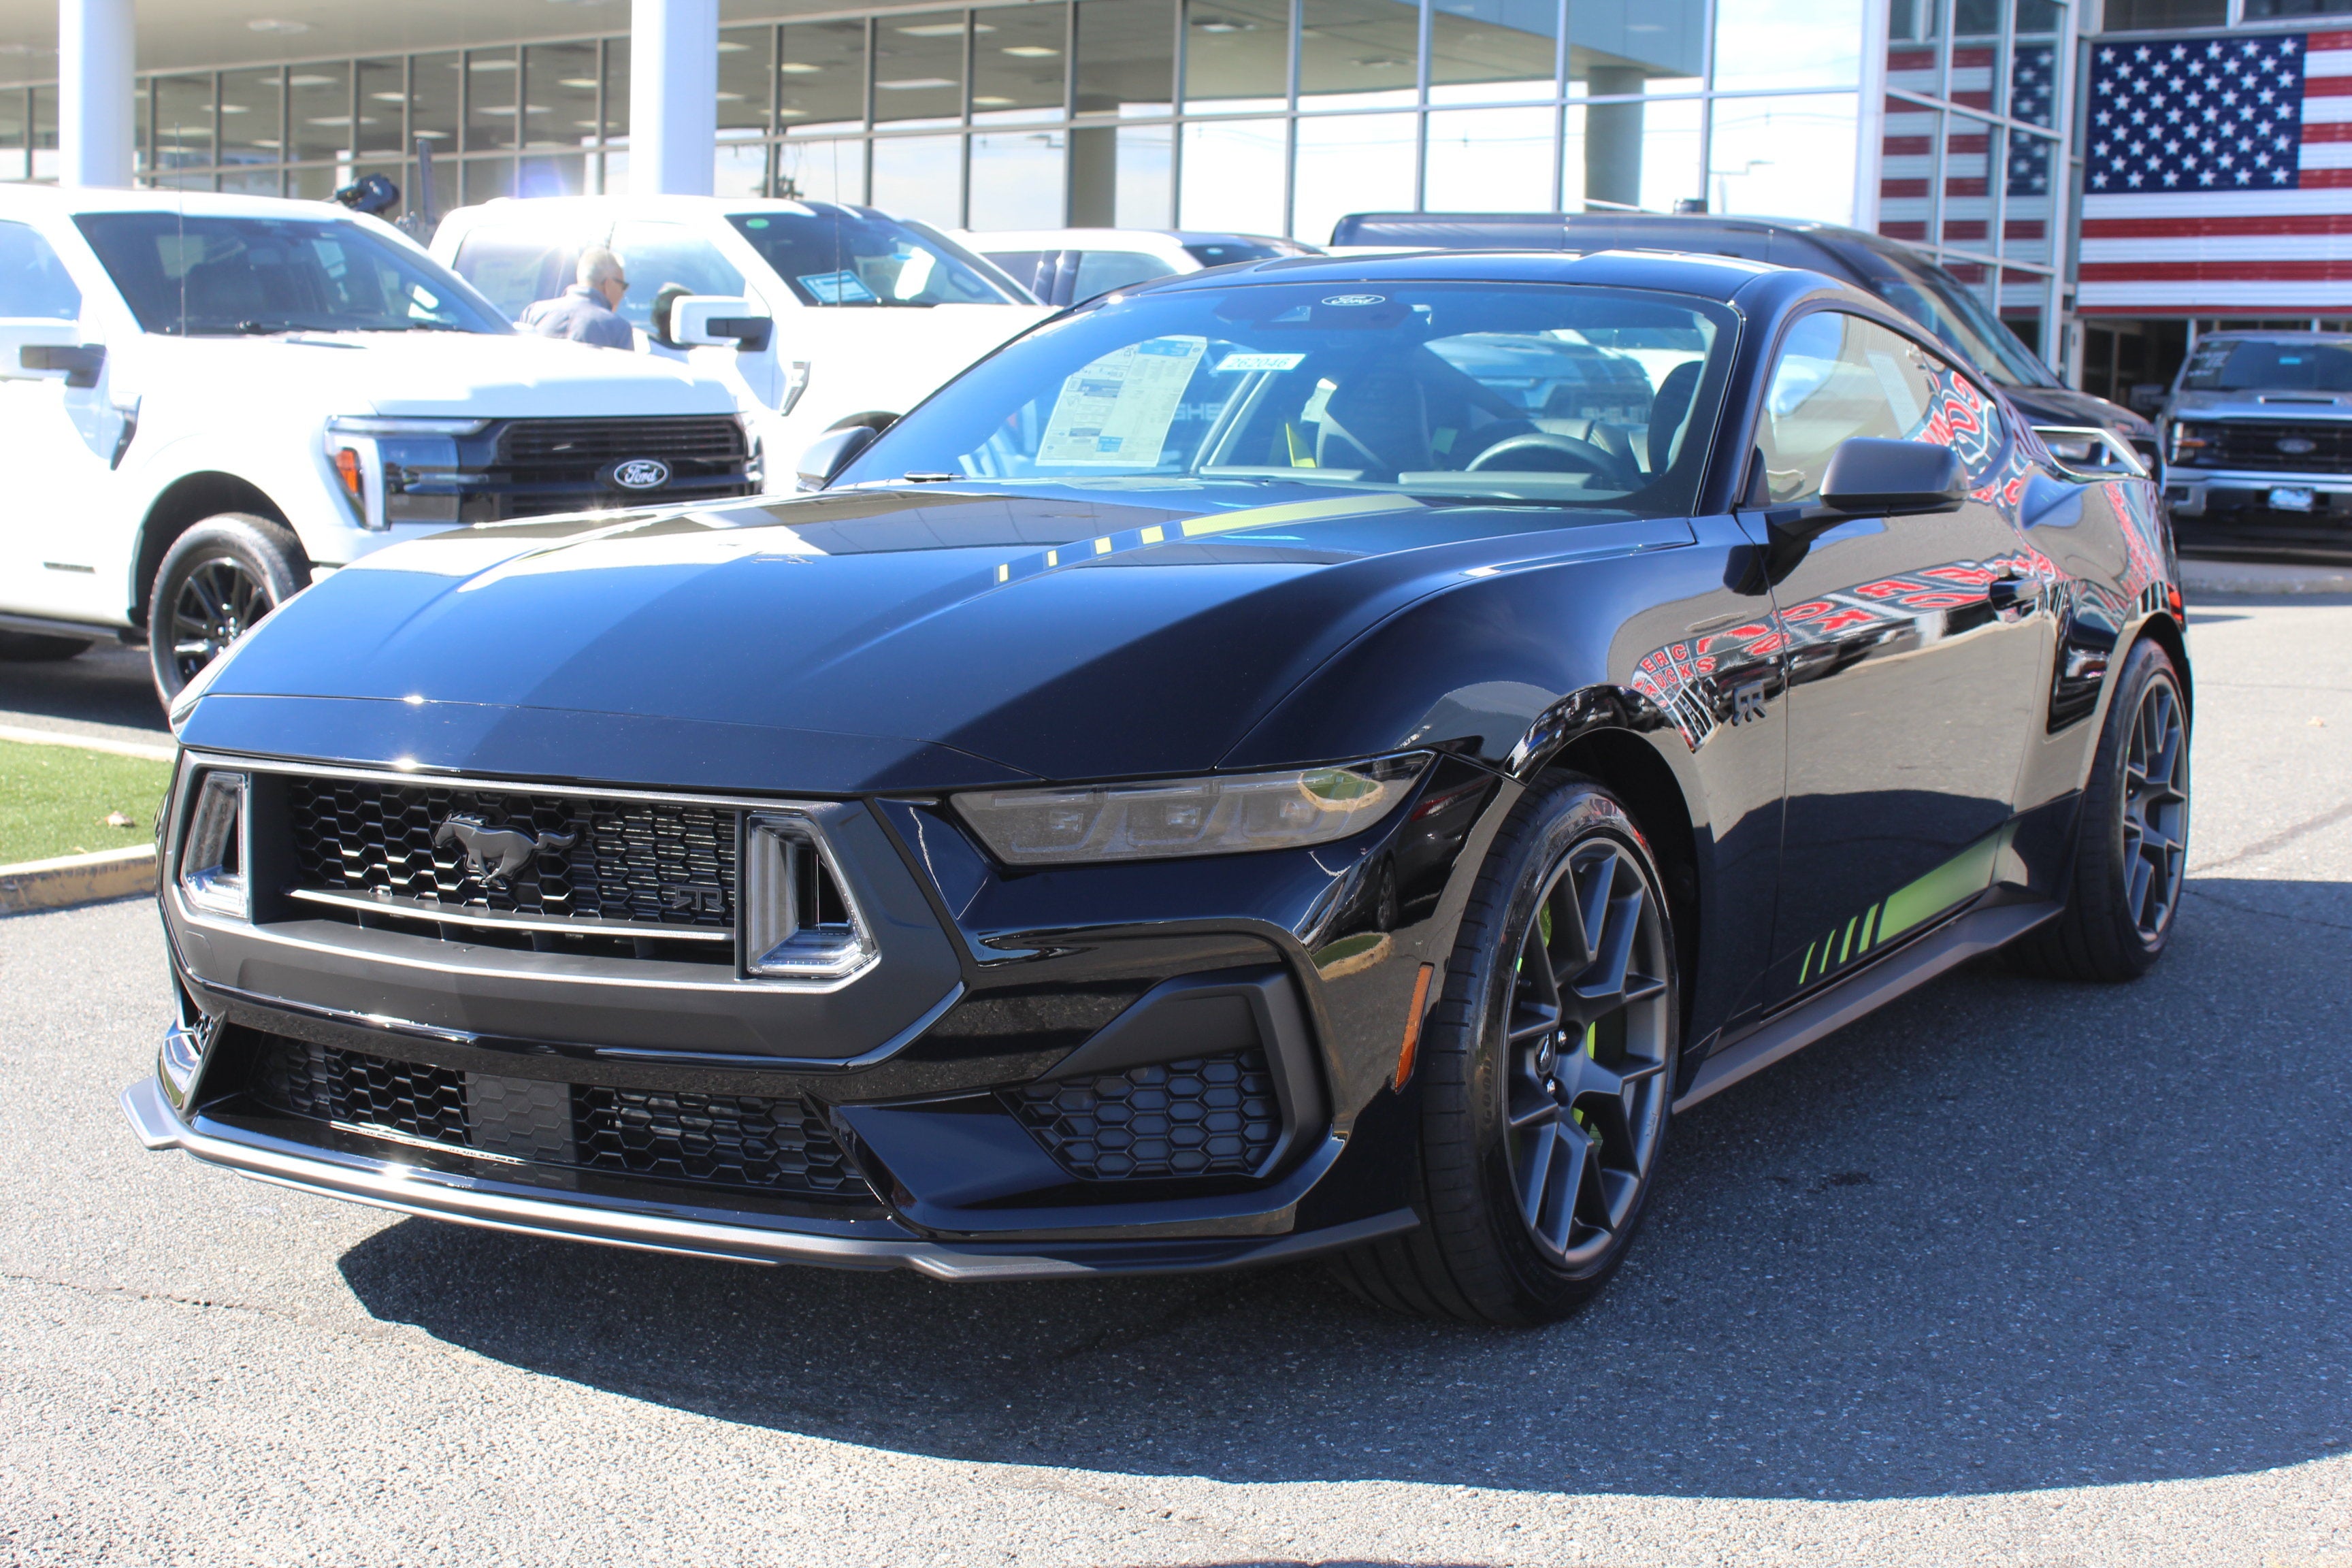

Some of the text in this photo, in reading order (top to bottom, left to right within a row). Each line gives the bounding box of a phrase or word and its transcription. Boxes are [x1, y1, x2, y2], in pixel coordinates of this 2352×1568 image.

[1329, 295, 1377, 305] Ford
[1226, 357, 1291, 368] 262046
[623, 462, 660, 485] Ford
[672, 885, 725, 913] RTR
